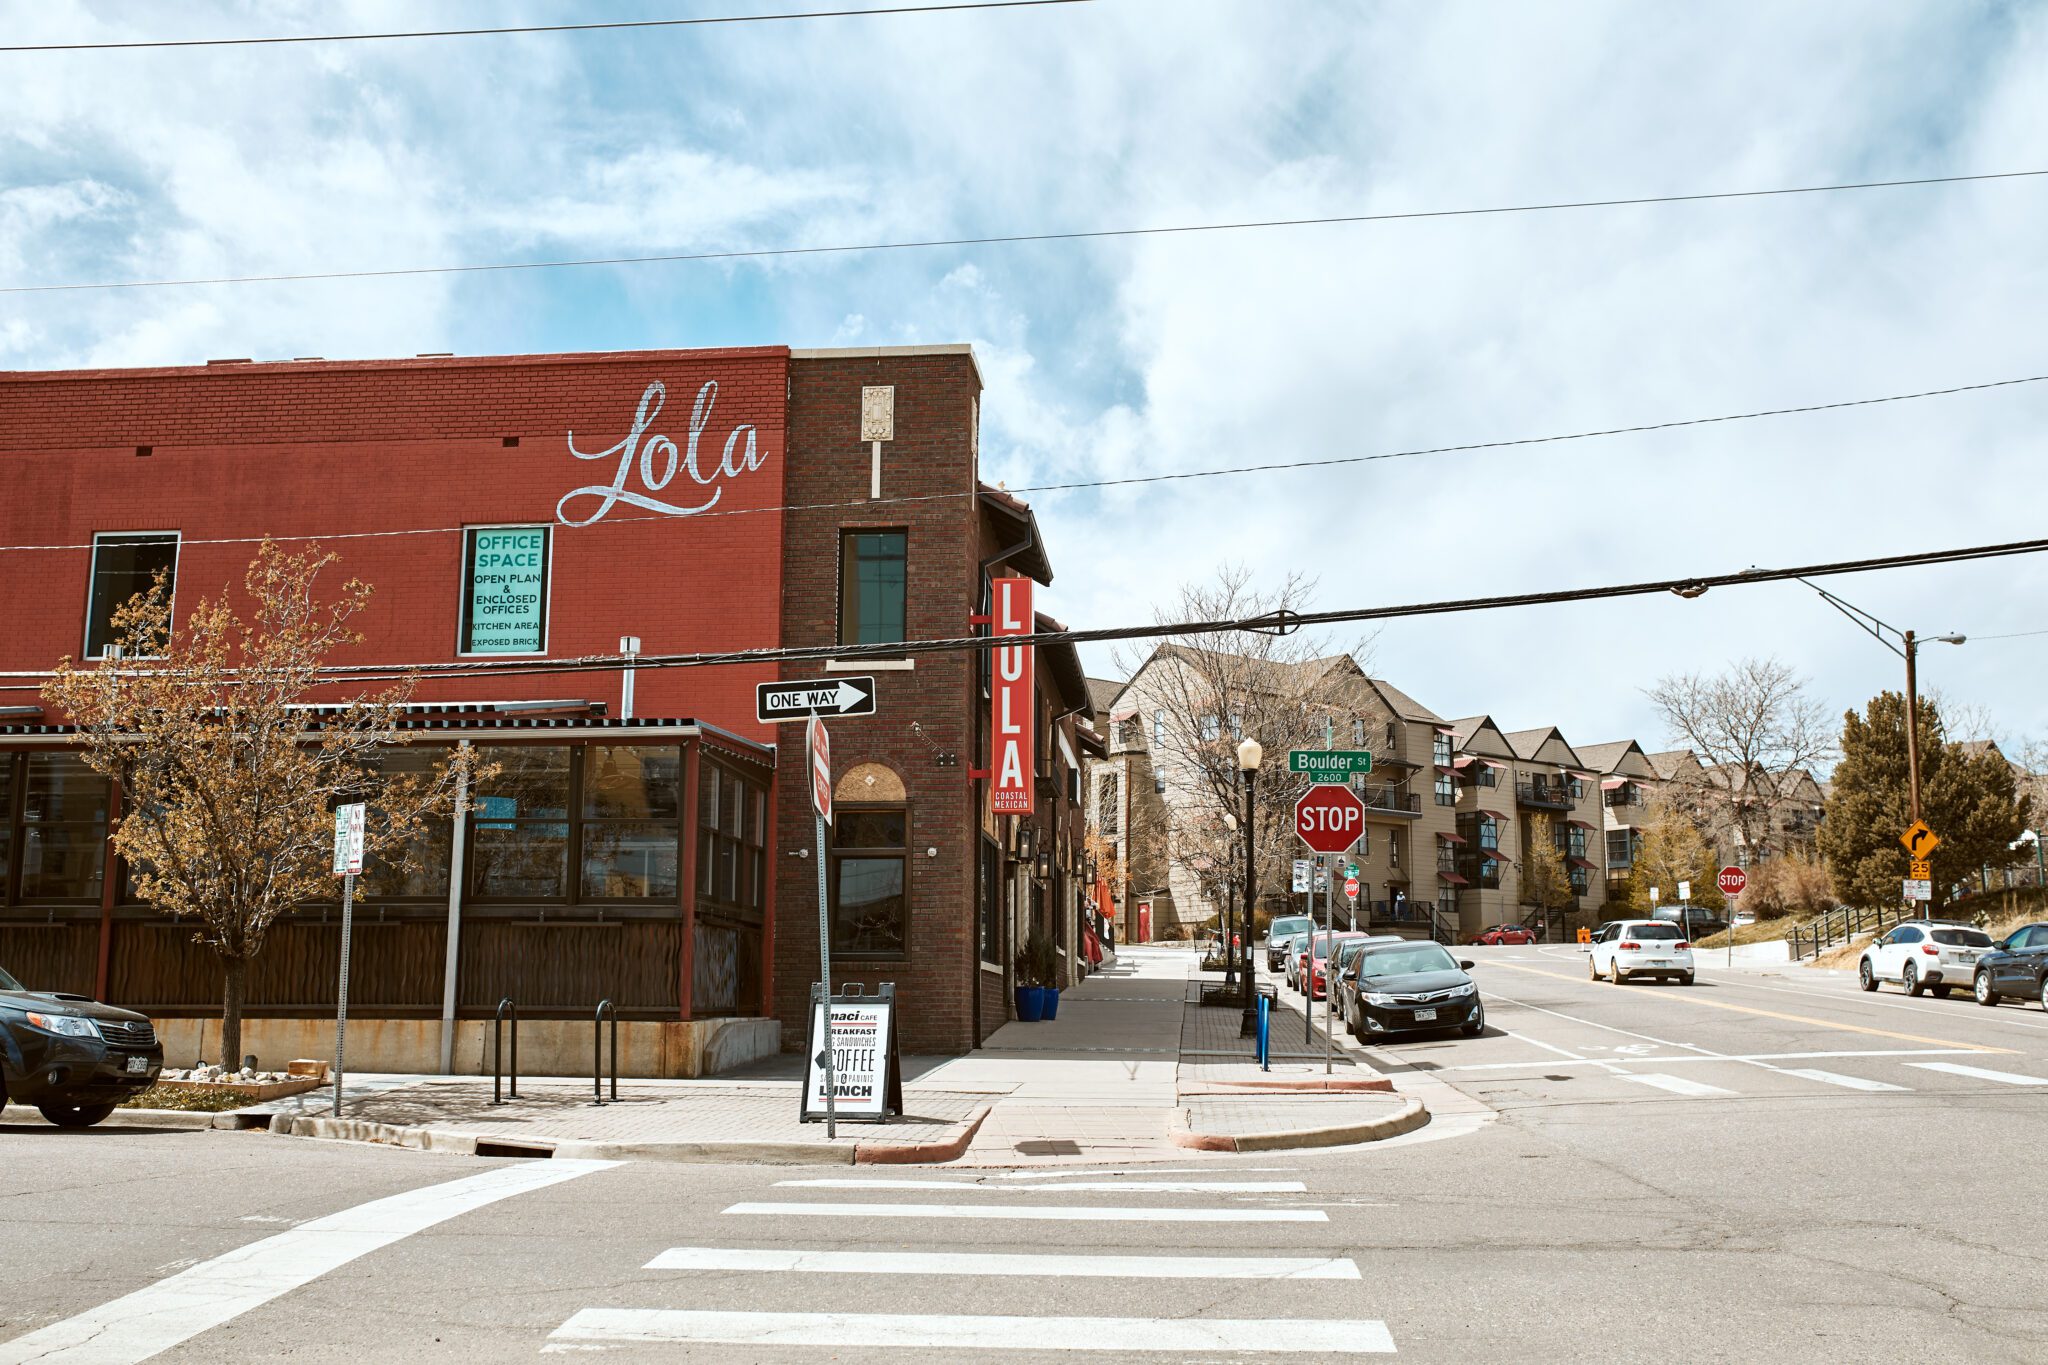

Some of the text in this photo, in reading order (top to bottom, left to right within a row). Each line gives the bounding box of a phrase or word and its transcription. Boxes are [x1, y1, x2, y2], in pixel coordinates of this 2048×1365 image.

[556, 380, 769, 527] Lola
[478, 536, 540, 550] OFFICE
[478, 554, 538, 567] SPACE
[475, 574, 540, 584] OPEN PLAN
[503, 585, 511, 594] &
[476, 595, 537, 604] ENCLOSED
[483, 605, 529, 614] OFFICES
[513, 638, 538, 646] BRICK
[770, 690, 838, 708] ONE WAY
[1298, 754, 1366, 770] Boulder St
[1317, 774, 1342, 782] 2600
[995, 792, 1028, 800] COASTAL
[1301, 806, 1359, 832] STOP
[1912, 862, 1928, 872] 25
[1720, 874, 1744, 886] STOP
[1346, 884, 1358, 892] STOP
[836, 1036, 876, 1046] SANDWICHES
[848, 1074, 874, 1082] PANINIS
